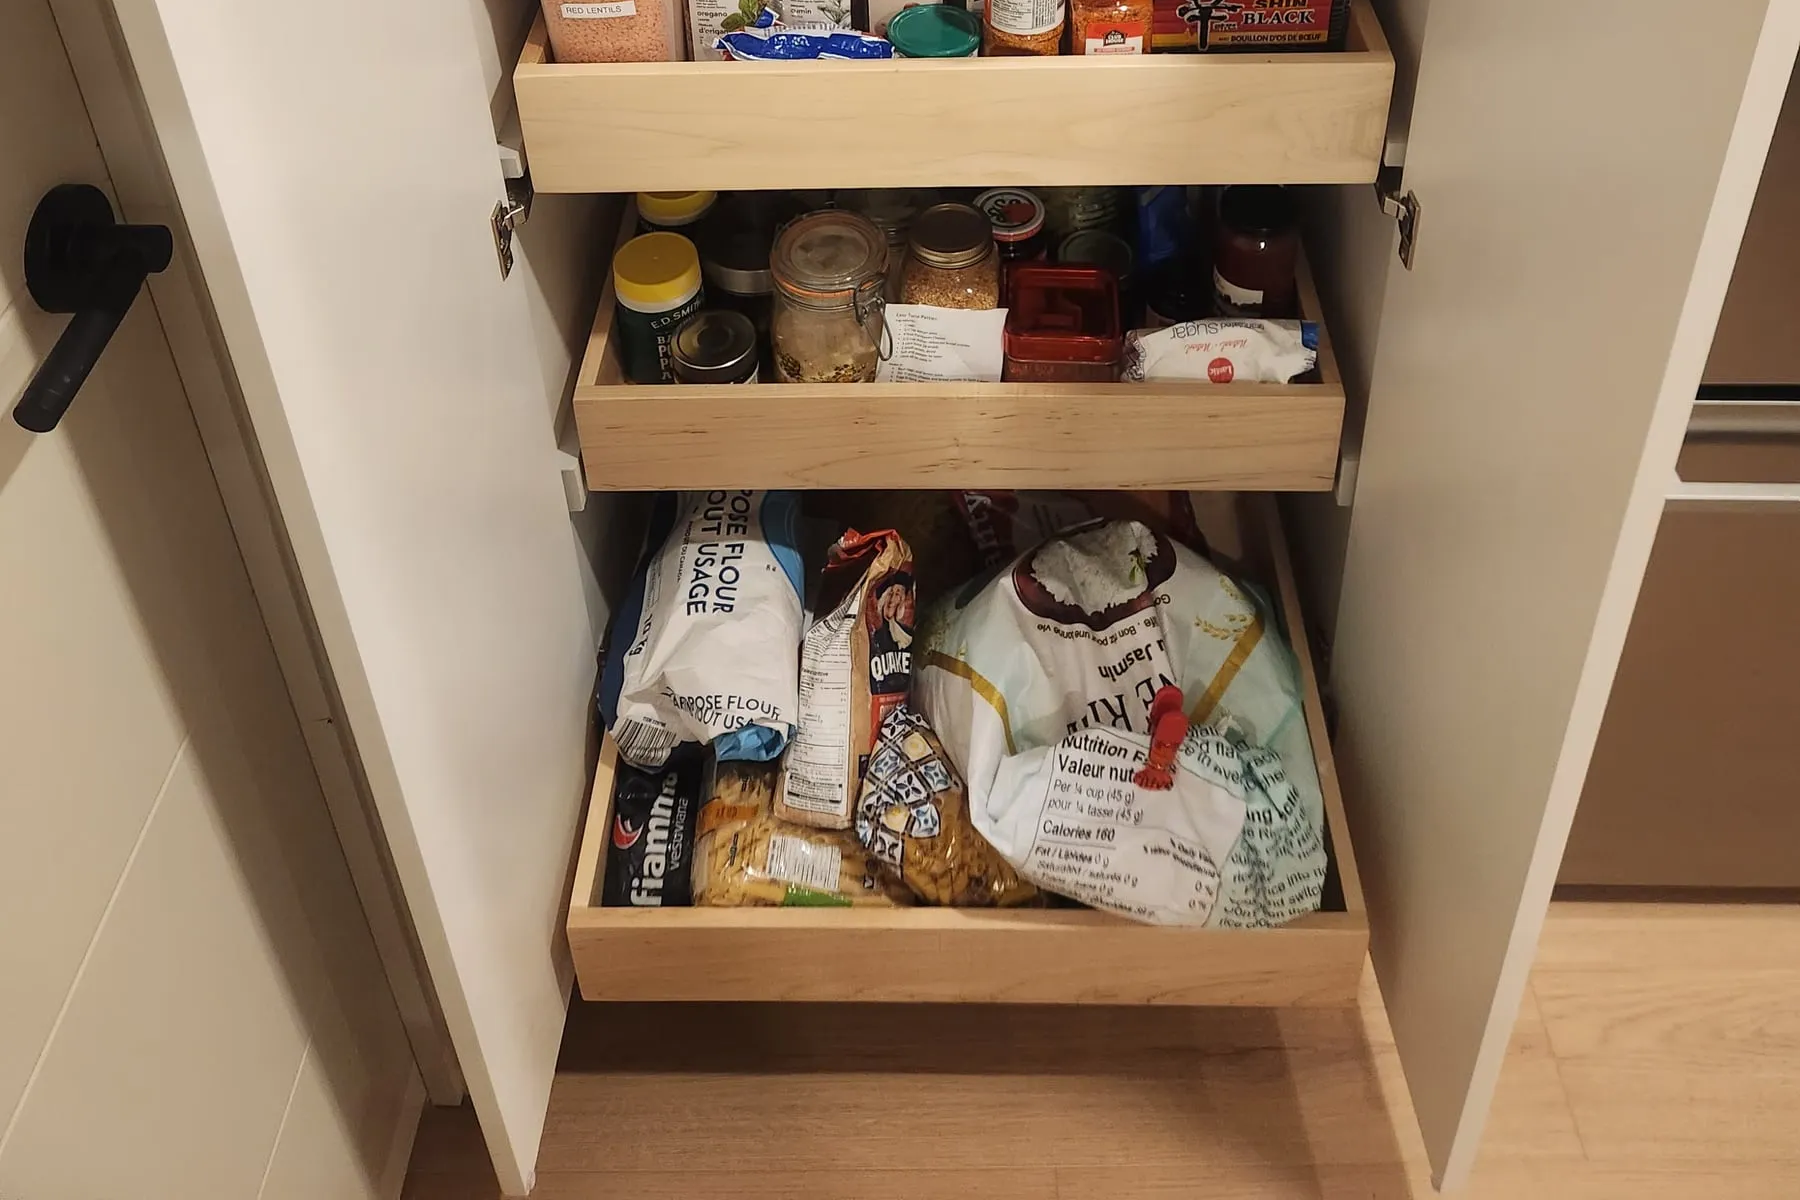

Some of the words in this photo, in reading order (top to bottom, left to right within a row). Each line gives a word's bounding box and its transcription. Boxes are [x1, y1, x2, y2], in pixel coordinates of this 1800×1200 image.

[566, 6, 584, 14] RED
[586, 5, 622, 14] LENTILS
[697, 10, 728, 18] oregano
[1242, 8, 1315, 25] BLACK
[1231, 33, 1269, 42] BOUILLON
[1208, 365, 1233, 376] Lantic
[686, 543, 719, 616] USAGE
[712, 543, 745, 613] FLOUR
[1037, 623, 1052, 632] vie
[1076, 629, 1091, 640] une
[1119, 624, 1137, 638] Bon
[1098, 643, 1153, 682] Jasmin
[1061, 734, 1129, 759] Nutrition
[1058, 754, 1105, 779] Valeur
[1053, 779, 1071, 793] Per
[1086, 788, 1104, 801] cup
[1047, 798, 1072, 811] pour
[1088, 804, 1114, 818] tasse
[1043, 819, 1092, 840] Calories
[1096, 827, 1116, 842] 160
[1034, 846, 1052, 858] Fat
